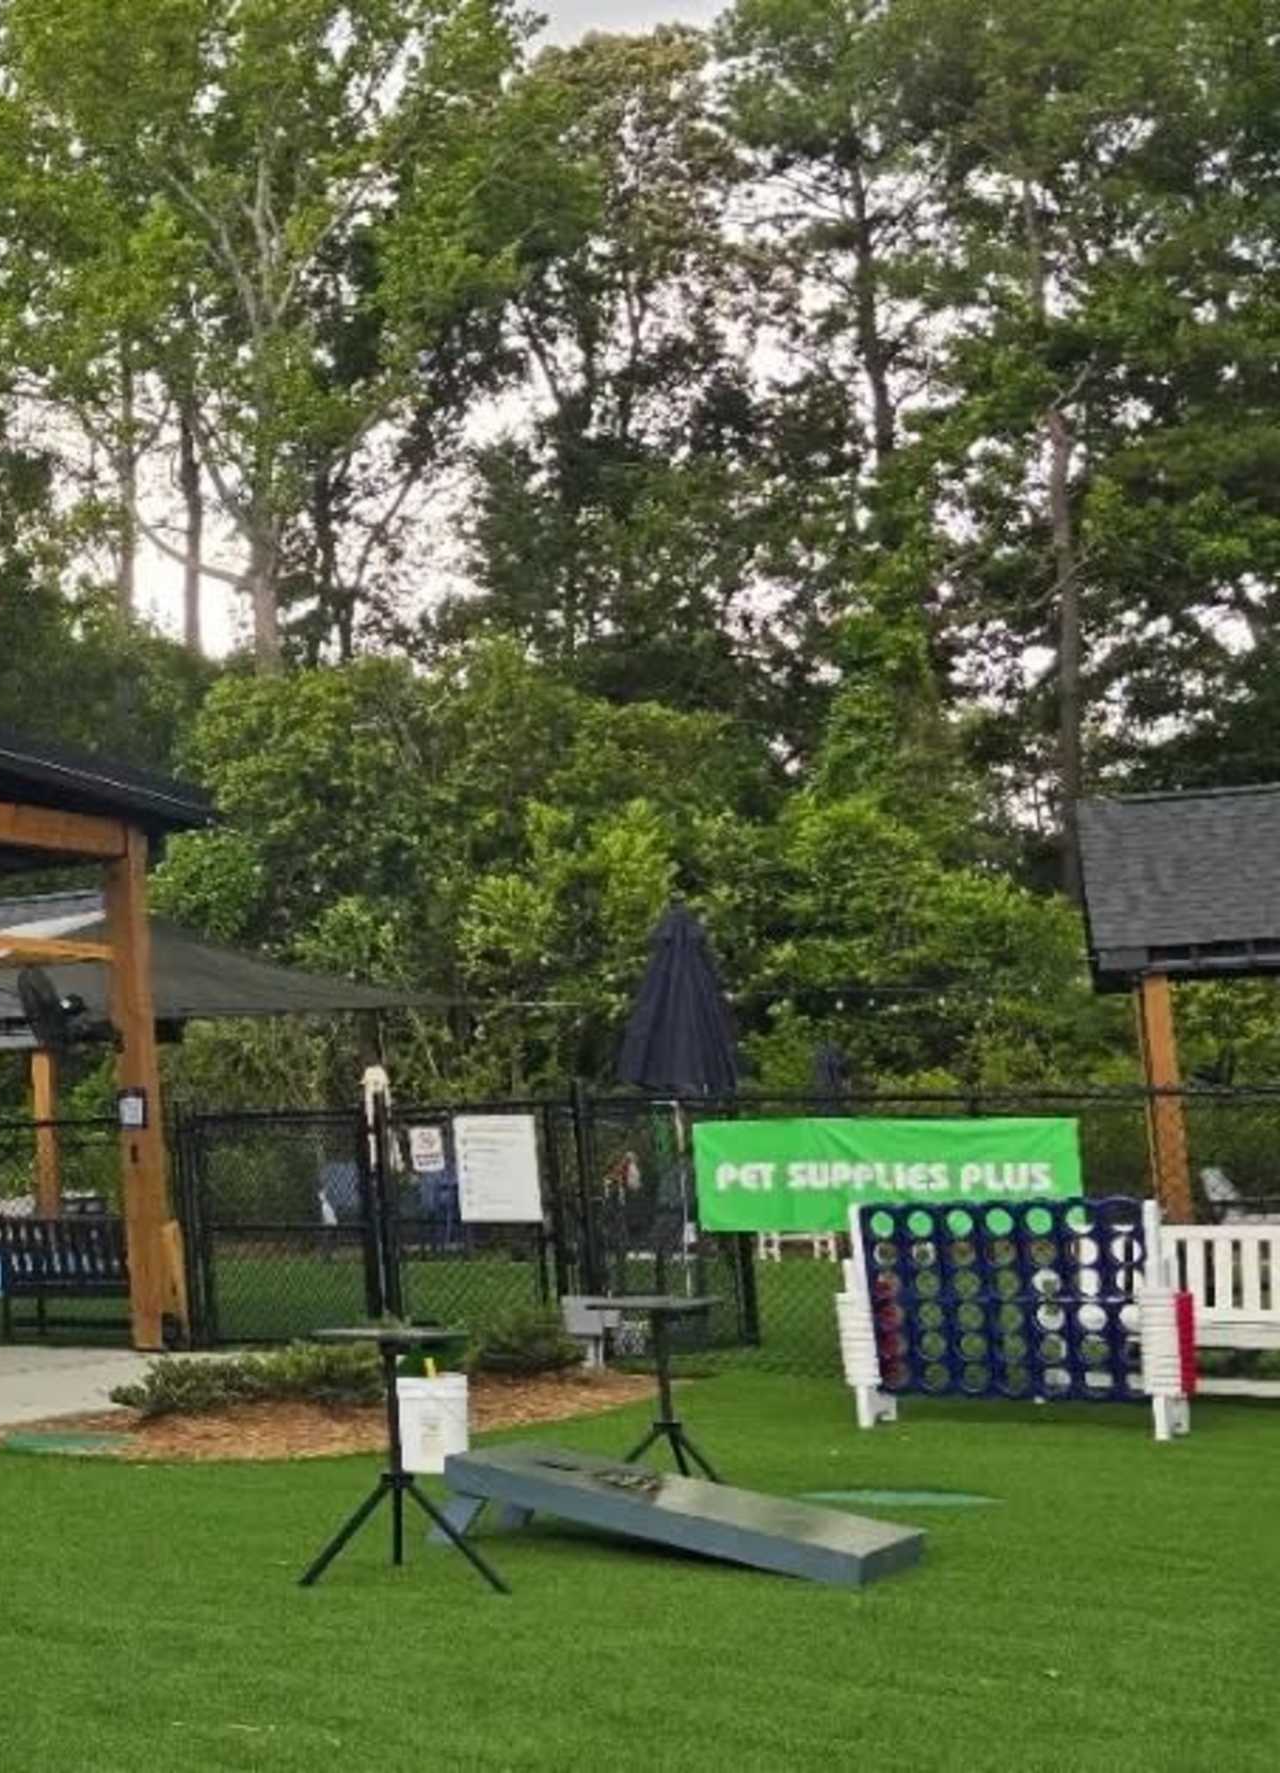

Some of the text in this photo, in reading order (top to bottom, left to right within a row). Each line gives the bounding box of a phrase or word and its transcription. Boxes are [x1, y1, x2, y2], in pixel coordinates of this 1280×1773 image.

[715, 1160, 1054, 1193] PET SUPPLIES PLUS
